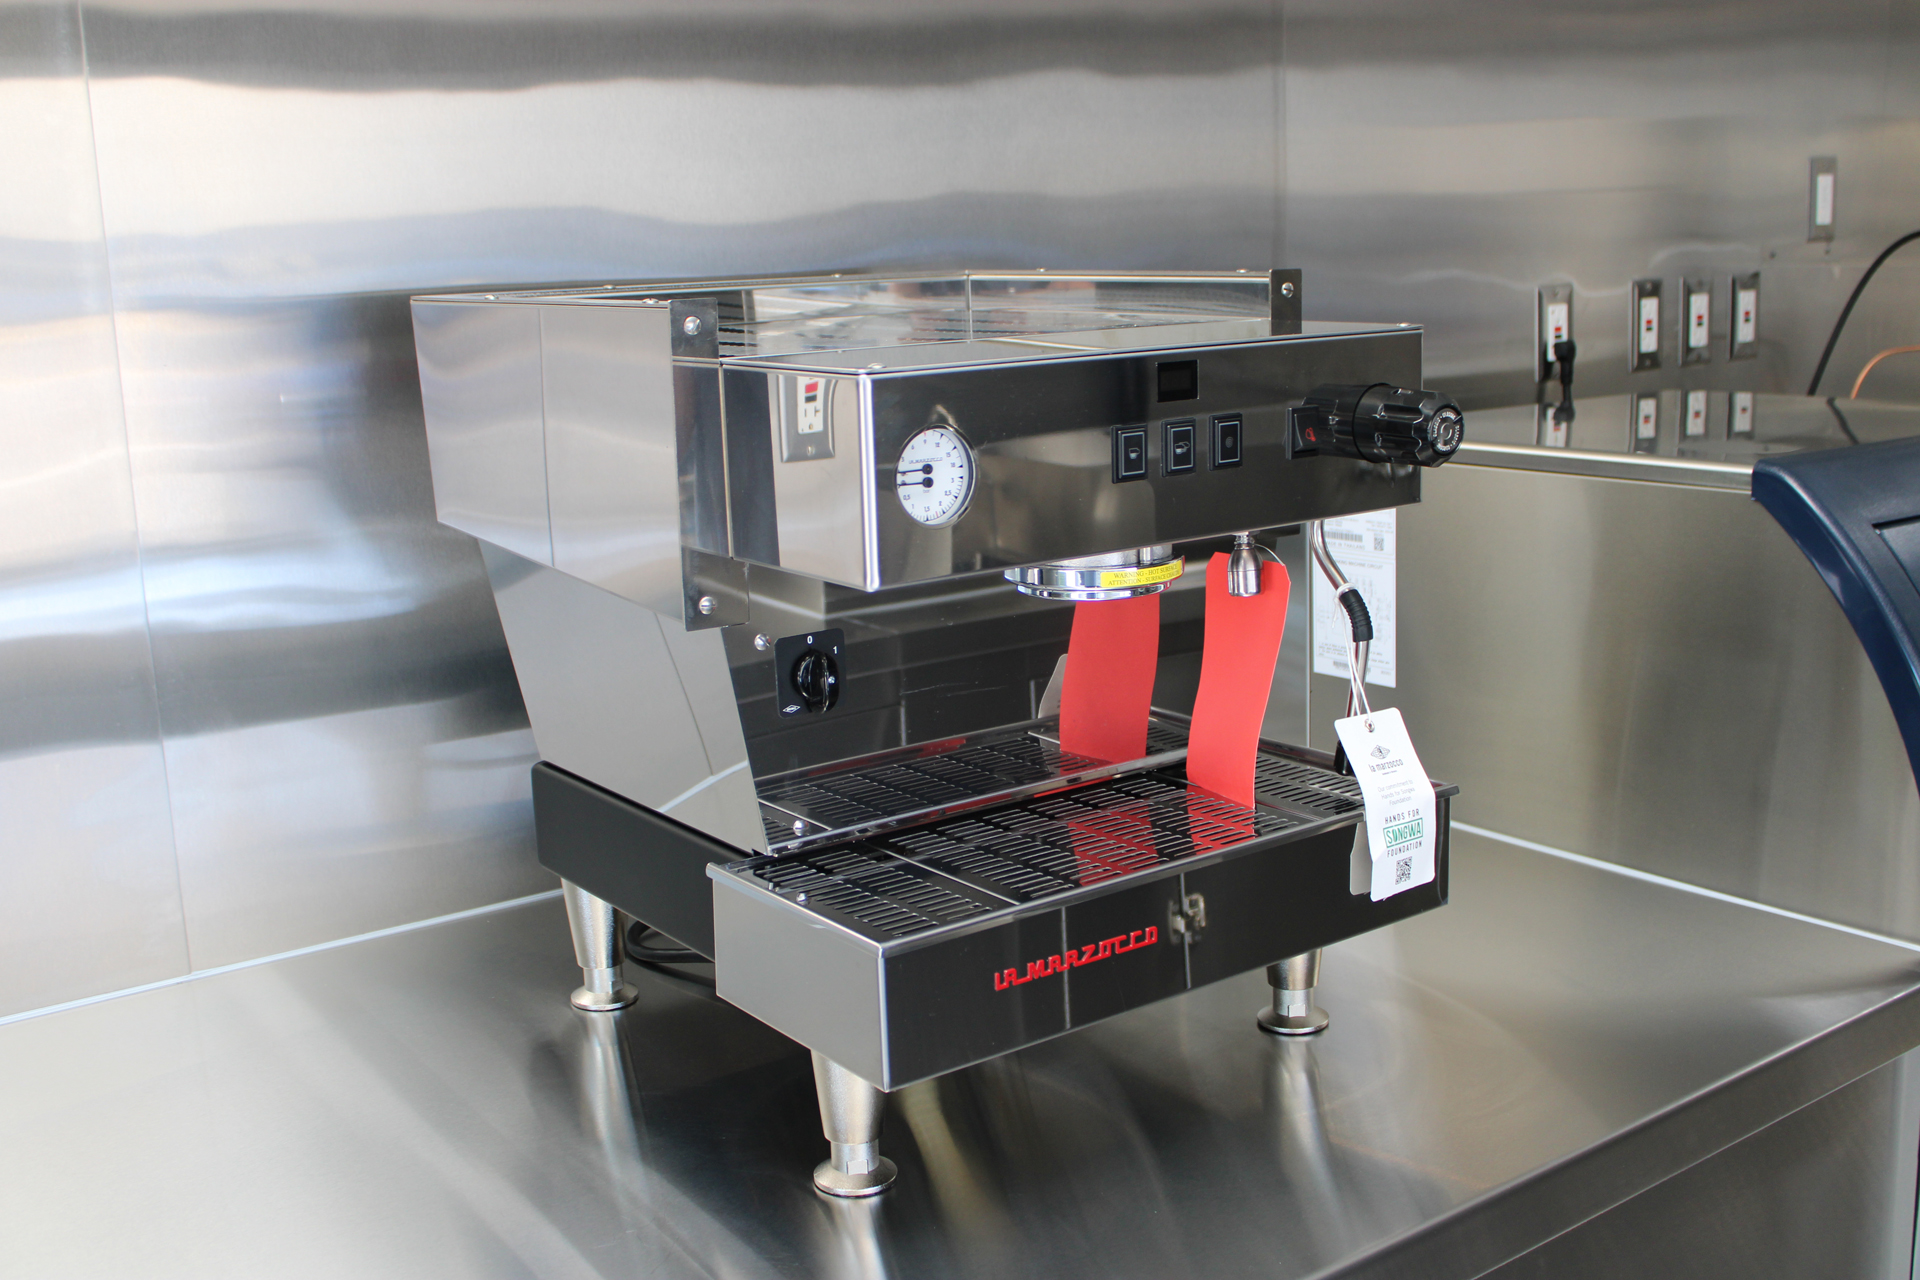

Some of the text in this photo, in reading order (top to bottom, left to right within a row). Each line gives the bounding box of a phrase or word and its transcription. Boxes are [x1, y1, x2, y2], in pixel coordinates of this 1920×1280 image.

[1108, 578, 1142, 586] ATTENTION
[1146, 574, 1166, 582] SURFACE
[1114, 570, 1144, 578] WARNING
[807, 635, 813, 644] 0
[833, 646, 838, 654] 1
[1368, 764, 1376, 772] la
[1376, 759, 1404, 771] marzocco
[1385, 808, 1419, 824] HANDS FOR
[1386, 822, 1421, 844] SONGWA
[1387, 840, 1422, 858] FOUNDATION
[994, 926, 1158, 992] LA MARZOCCO
